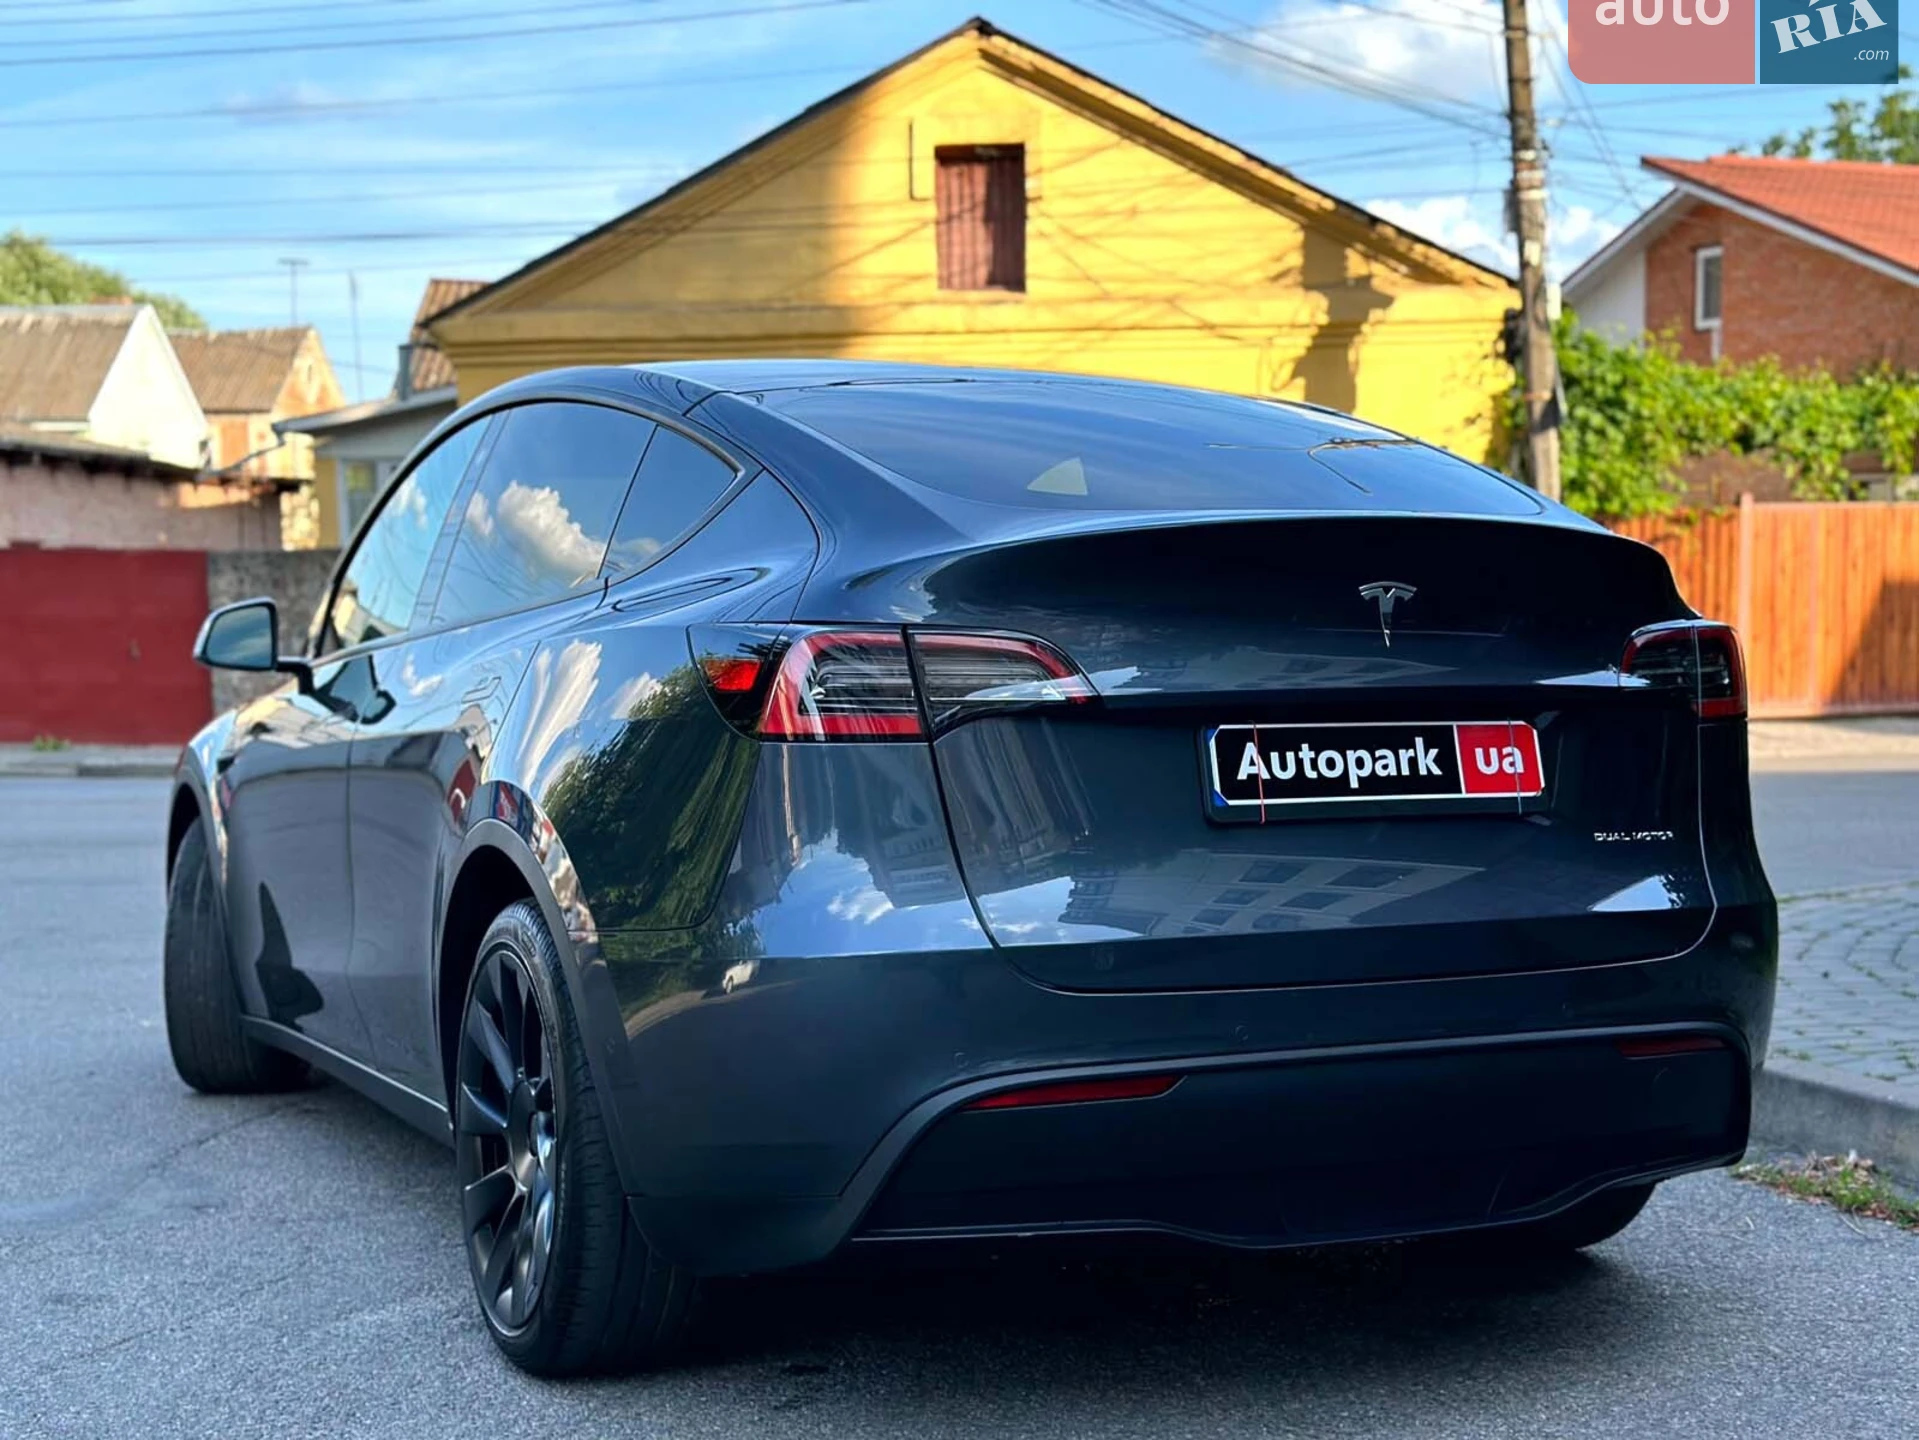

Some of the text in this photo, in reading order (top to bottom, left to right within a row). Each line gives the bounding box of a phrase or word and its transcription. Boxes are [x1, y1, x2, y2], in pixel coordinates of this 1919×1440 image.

[1236, 737, 1525, 789] Autopark ua
[1593, 830, 1674, 841] DUAL MOTOR
